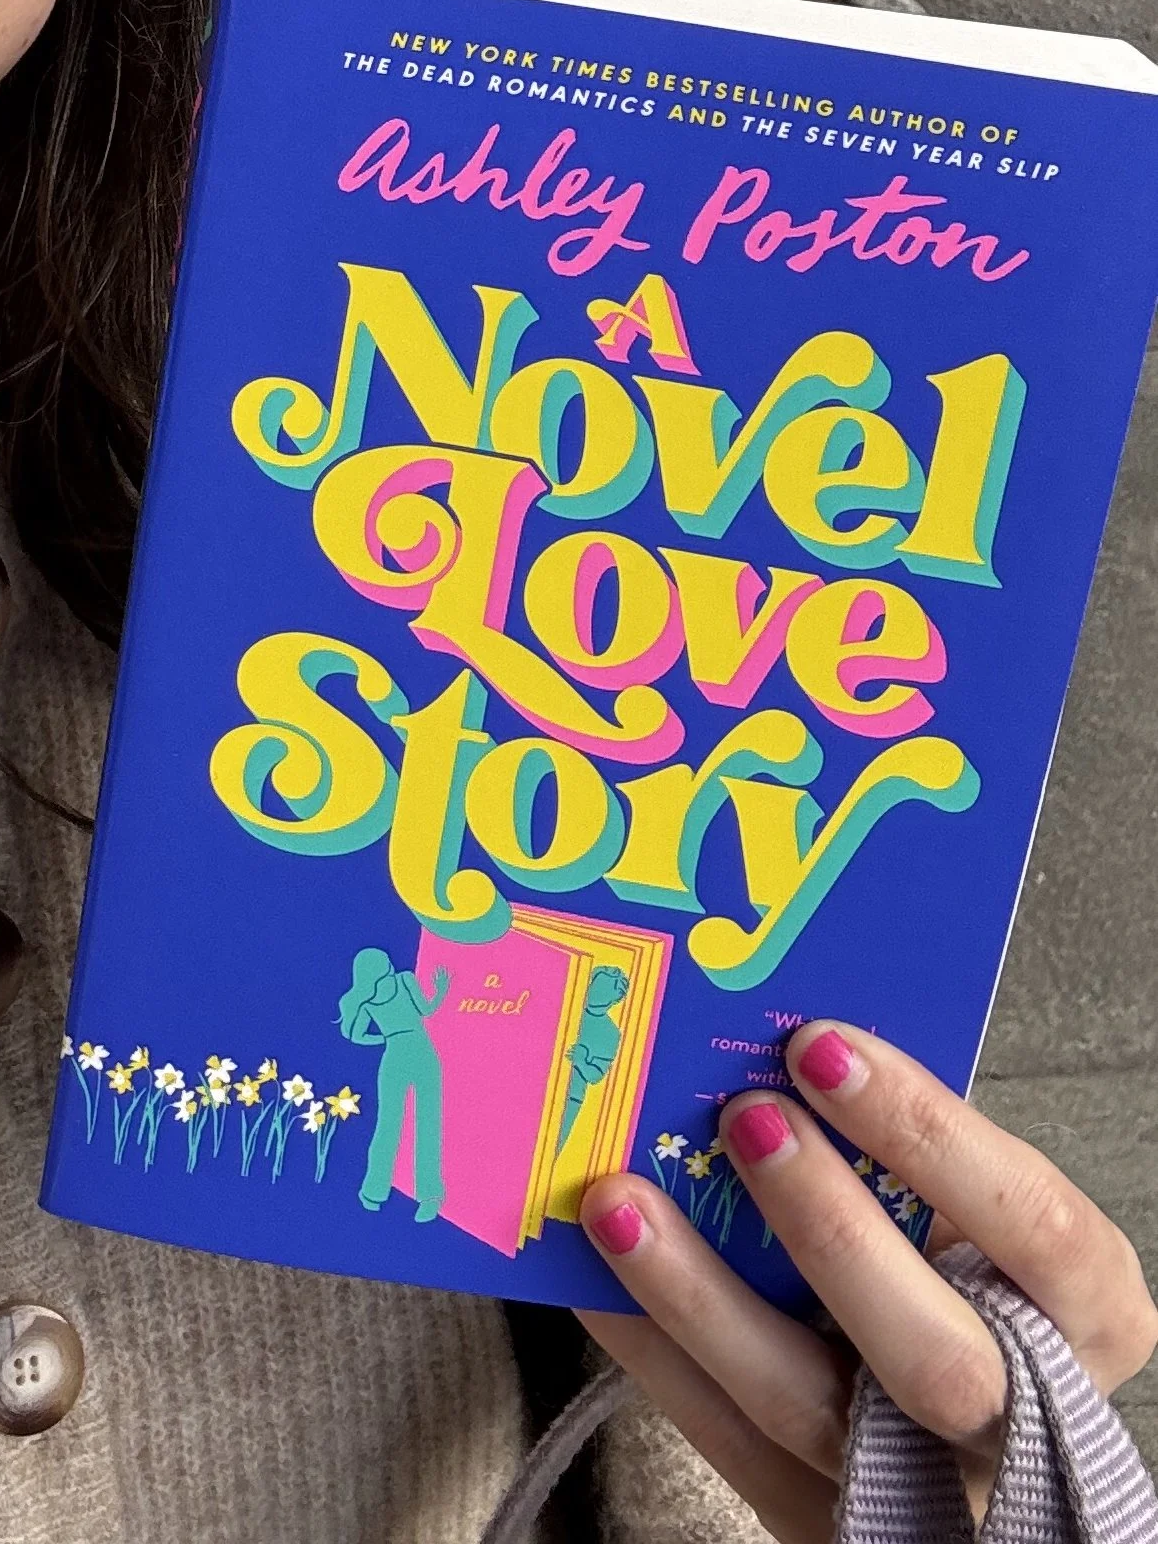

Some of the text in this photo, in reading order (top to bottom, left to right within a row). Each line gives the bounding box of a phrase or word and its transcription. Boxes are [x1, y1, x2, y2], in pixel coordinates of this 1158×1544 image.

[343, 51, 1059, 181] THE DEAD ROMANTICS AND THE SEVEN YEAR SLIP
[390, 31, 1018, 146] NEW YORK TIMES BESTSELLING AUTHOR OF
[338, 118, 1030, 282] Ashley Poston
[587, 273, 701, 376] A
[231, 261, 1027, 588] Novel
[312, 444, 947, 765] Love
[210, 631, 981, 992] Story
[458, 990, 531, 1014] novel
[484, 974, 501, 988] a
